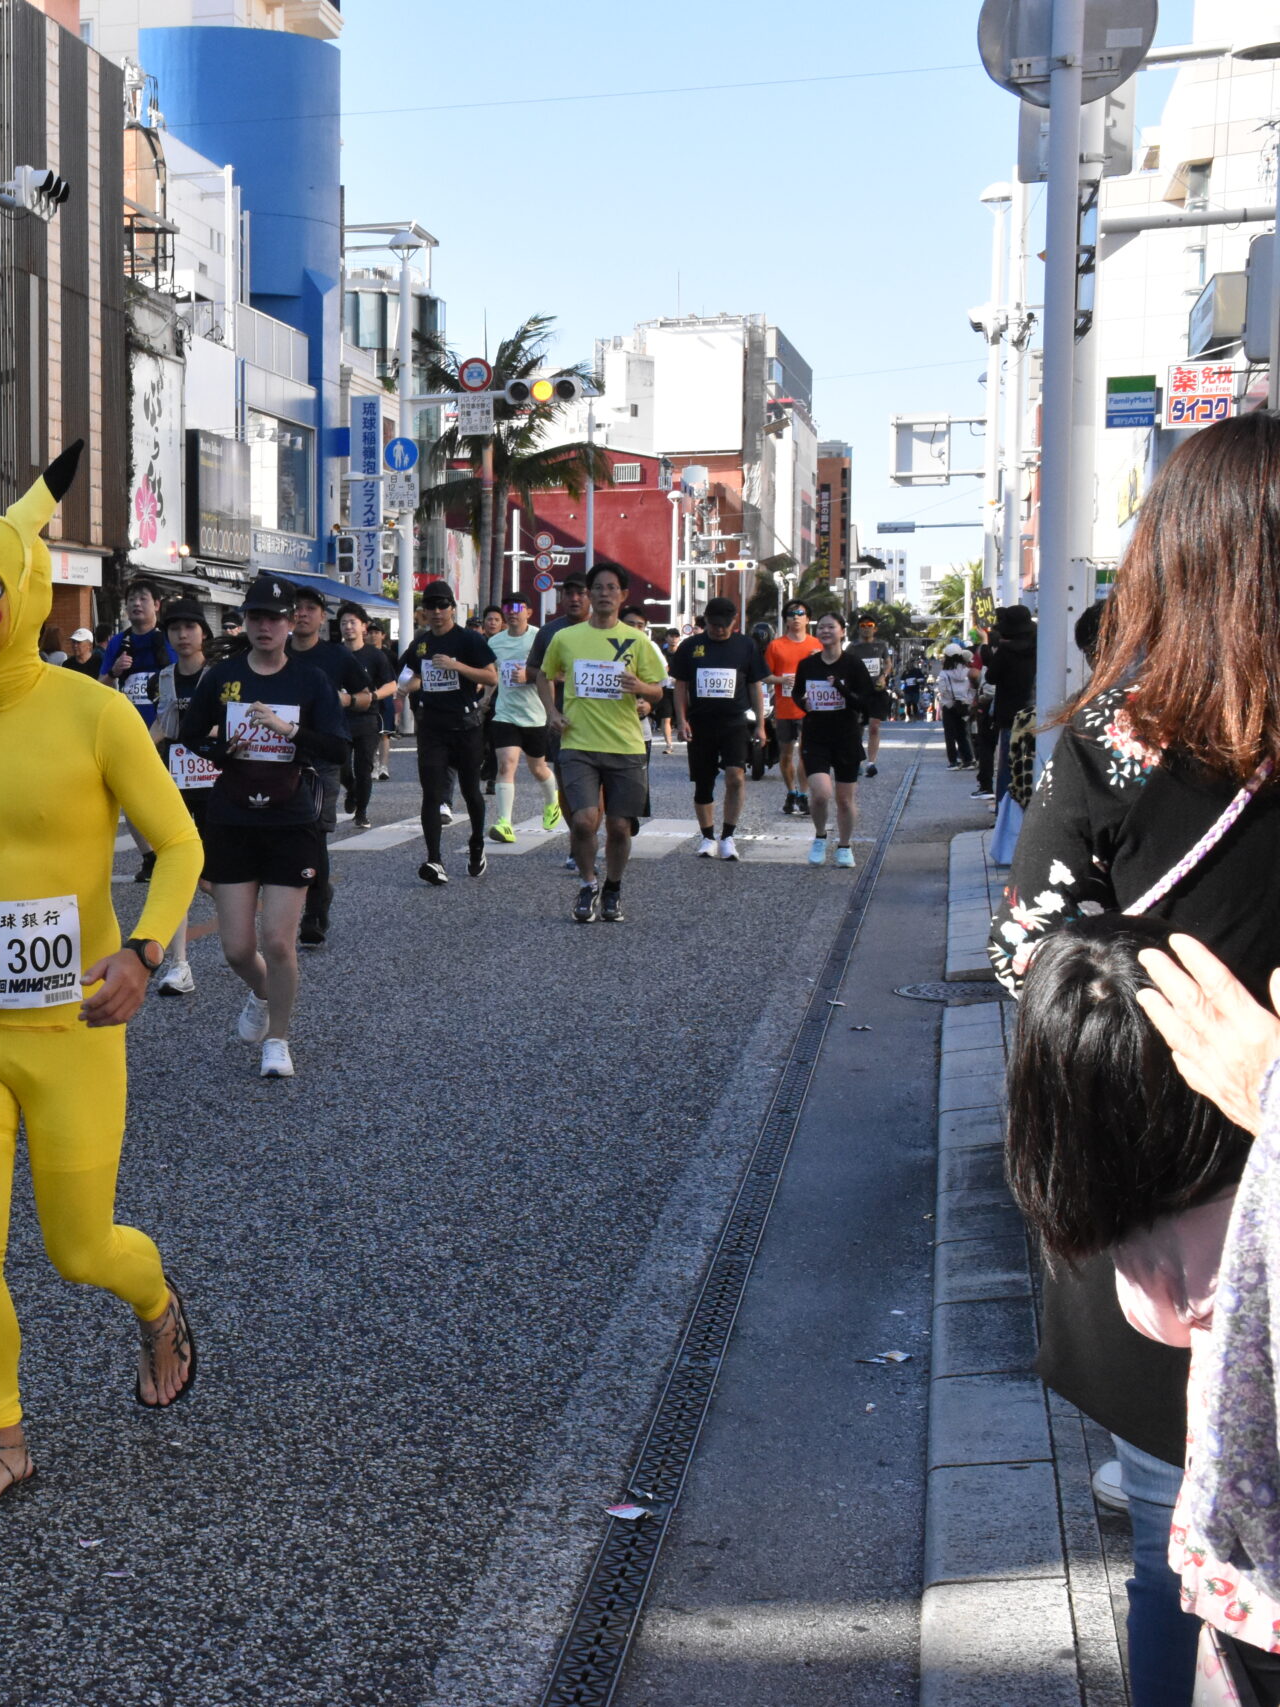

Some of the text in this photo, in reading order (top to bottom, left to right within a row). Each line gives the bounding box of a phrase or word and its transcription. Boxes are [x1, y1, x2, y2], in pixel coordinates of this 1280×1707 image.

[1173, 366, 1198, 392] 薬
[1201, 366, 1233, 385] 免税
[1109, 396, 1152, 406] FamilyMart
[1172, 398, 1229, 421] ダイコク
[574, 672, 620, 688] L21355
[697, 678, 734, 690] L19978
[227, 721, 292, 744] L2234
[171, 757, 222, 775] L1938
